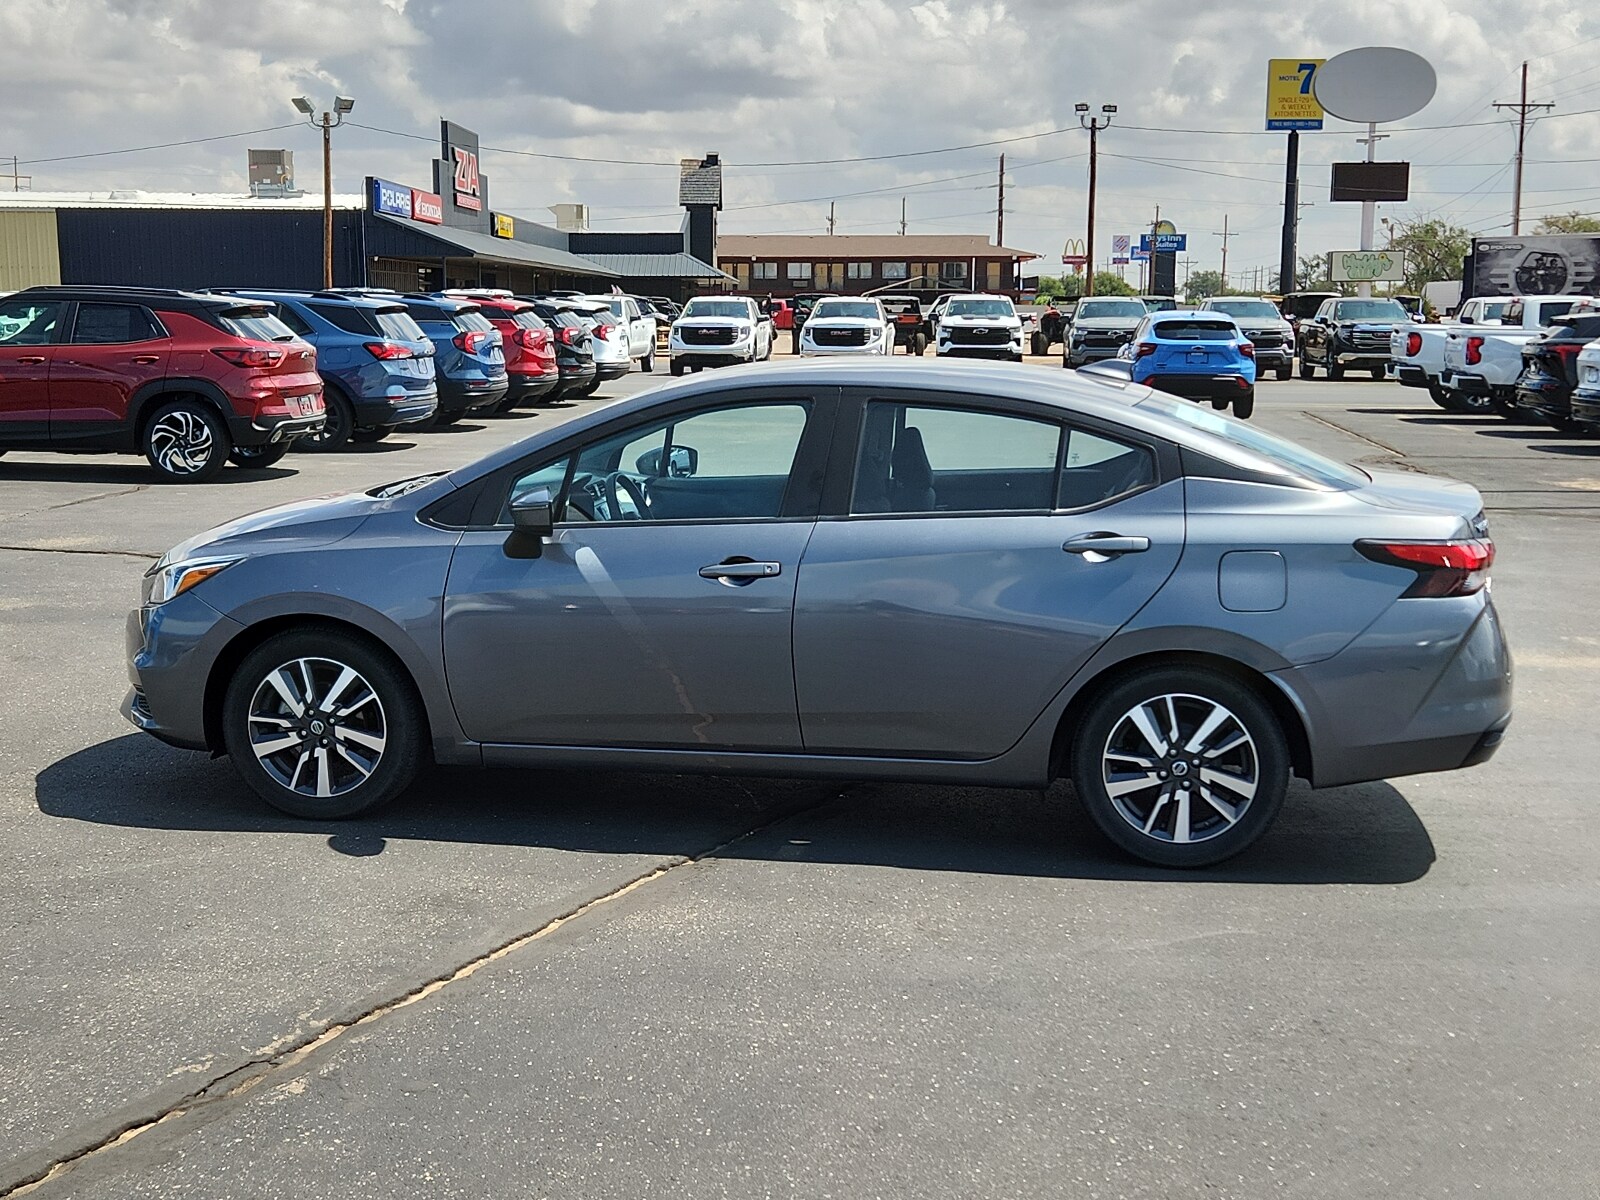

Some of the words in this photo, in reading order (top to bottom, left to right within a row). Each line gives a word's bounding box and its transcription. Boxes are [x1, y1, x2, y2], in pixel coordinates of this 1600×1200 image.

[1297, 63, 1317, 94] 7
[453, 147, 480, 197] ZIA
[381, 188, 410, 211] POLARIS
[421, 202, 442, 219] HONDA
